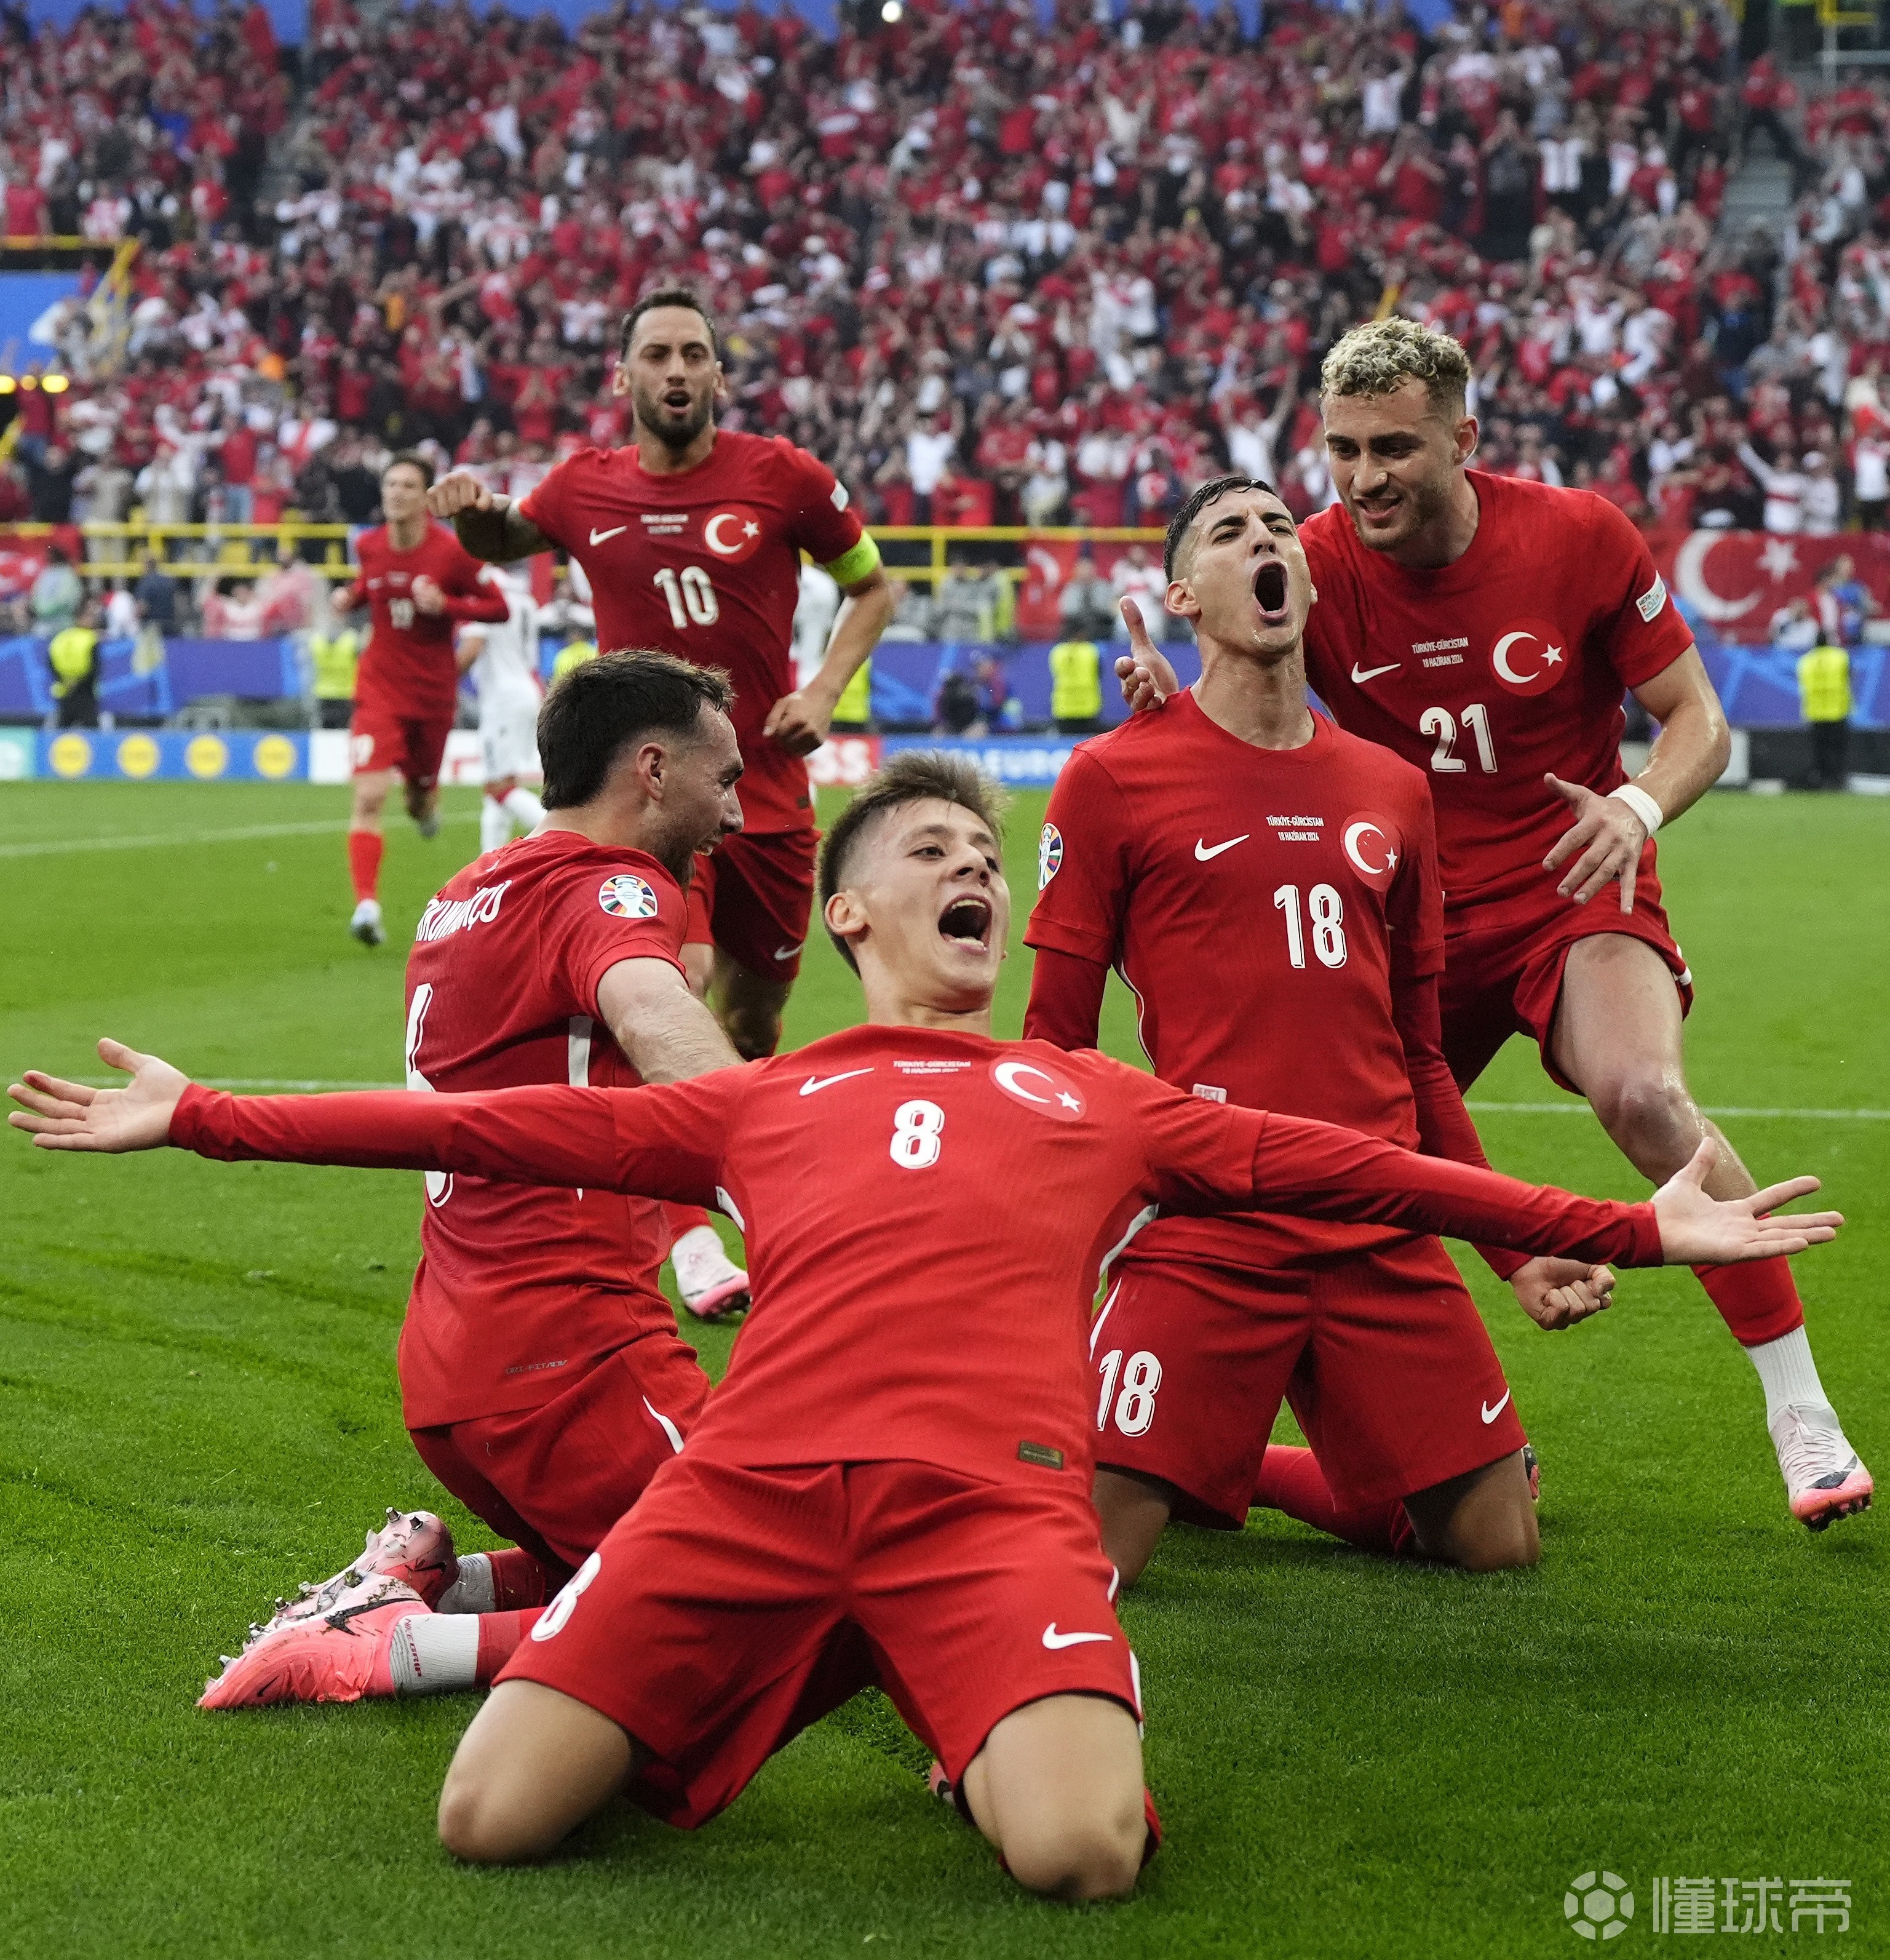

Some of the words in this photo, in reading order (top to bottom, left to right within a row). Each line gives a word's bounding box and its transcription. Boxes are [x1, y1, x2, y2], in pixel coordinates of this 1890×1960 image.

[653, 565, 720, 629] 10
[1419, 703, 1498, 773] 21
[1266, 815, 1325, 827] TÜRKİYE-GÜRCİSTAN
[1273, 883, 1348, 969] 18
[889, 1099, 945, 1169] 8
[1097, 1349, 1162, 1437] 18
[530, 1551, 602, 1642] 8
